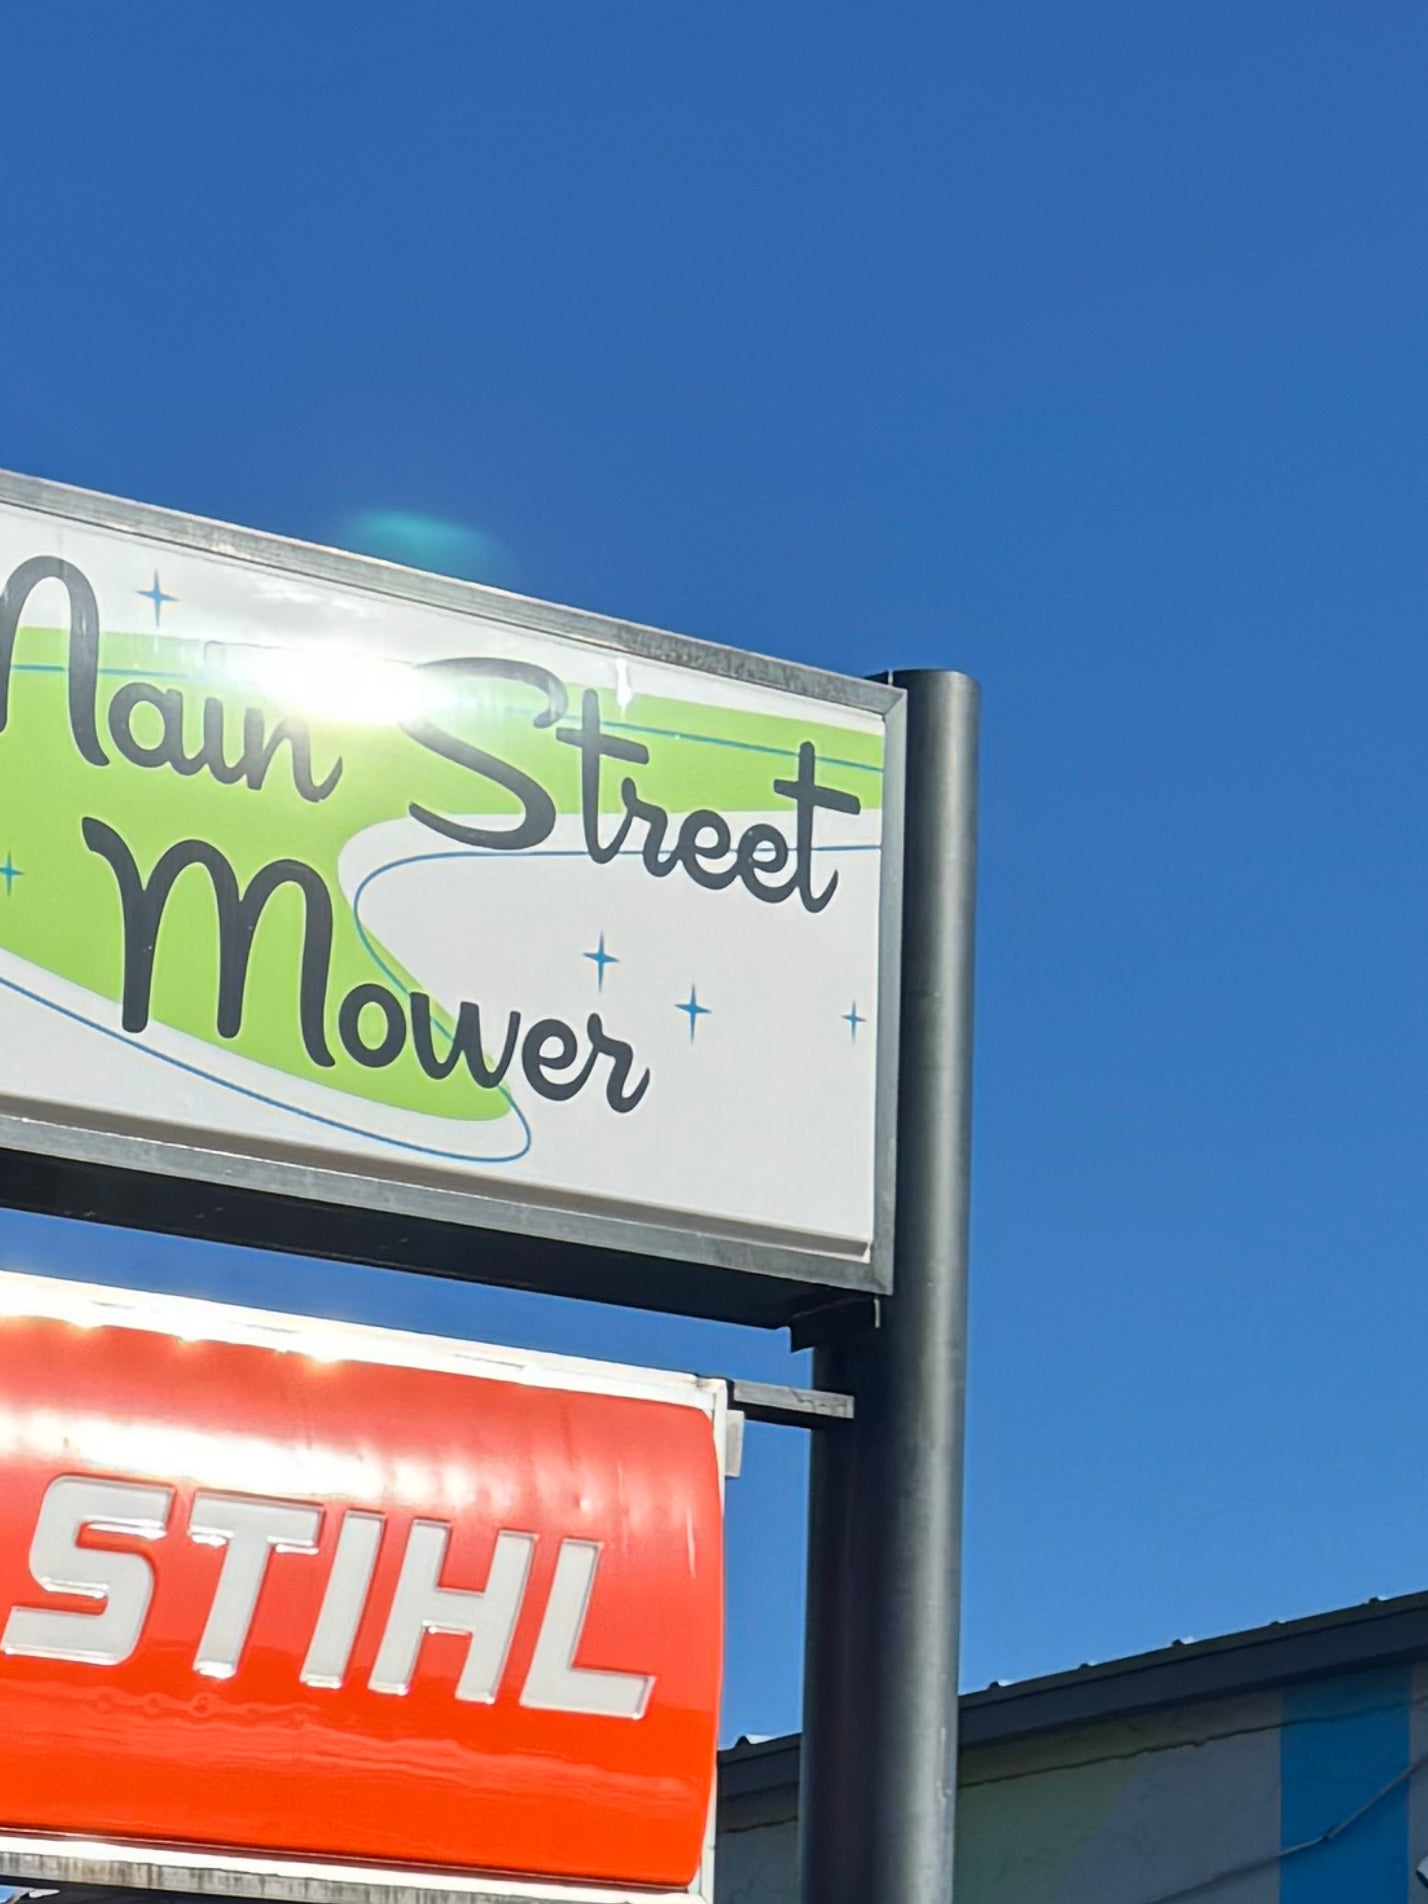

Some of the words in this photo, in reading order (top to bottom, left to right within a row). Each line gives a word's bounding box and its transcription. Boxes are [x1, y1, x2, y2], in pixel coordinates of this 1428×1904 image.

[390, 656, 862, 914] Street
[81, 815, 651, 1114] Mower
[0, 1473, 656, 1719] STIHL
